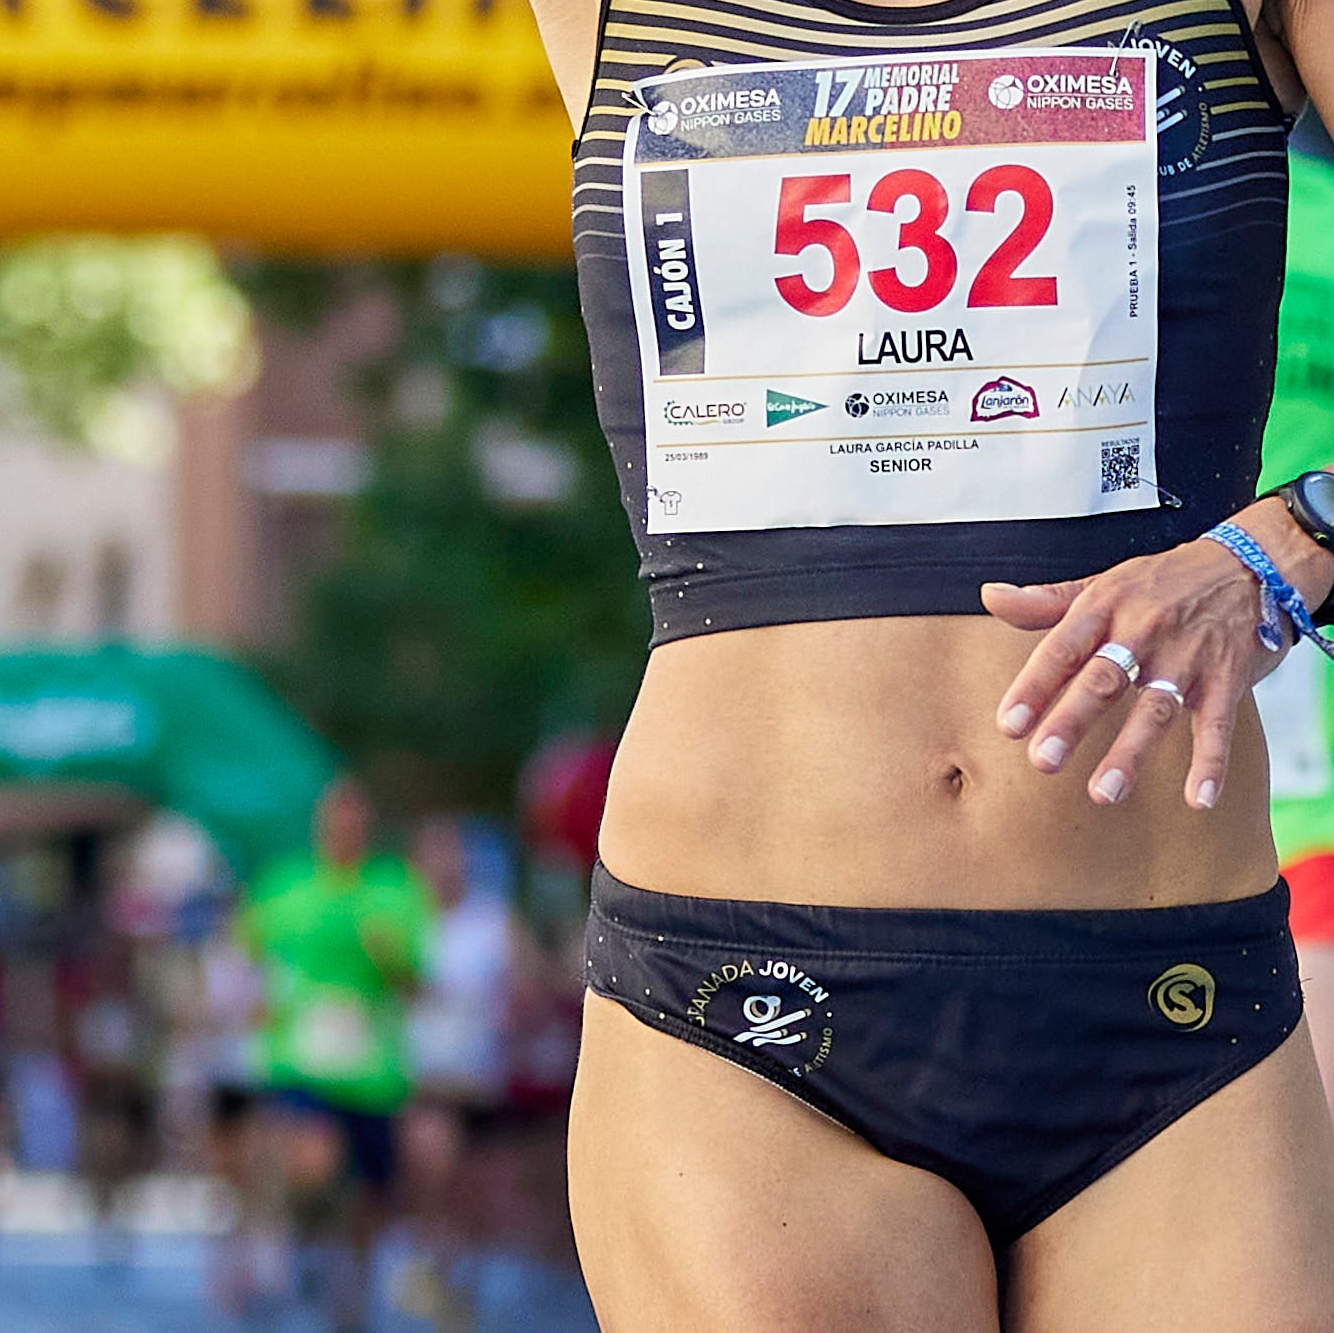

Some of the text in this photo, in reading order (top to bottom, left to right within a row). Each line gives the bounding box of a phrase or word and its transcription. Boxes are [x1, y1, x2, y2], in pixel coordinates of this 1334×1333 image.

[813, 63, 960, 117] 17 MEMORIAL
[1026, 74, 1134, 95] OXIMESA
[680, 88, 781, 115] OXIMESA
[864, 84, 954, 116] PADRE
[1027, 95, 1134, 111] NIPPON GASES
[680, 109, 781, 132] NIPPON GASES
[804, 110, 962, 146] MARCELINO
[1177, 157, 1193, 172] DE
[1126, 184, 1137, 215] 09:45
[773, 163, 1059, 317] 532
[1127, 218, 1137, 250] Salida
[653, 212, 696, 331] CAJÓN 1
[1128, 269, 1139, 318] PRUEBA
[857, 328, 973, 365] LAURA
[872, 390, 949, 406] OXIMESA
[980, 393, 1030, 410] Lanjarón
[1058, 382, 1136, 409] ANAYA
[670, 403, 745, 419] CALERO
[873, 406, 950, 418] NIPPON GASES
[829, 439, 980, 455] LAURA GARCÍA PADILLA
[869, 458, 932, 473] SENIOR
[758, 959, 830, 1004] JOVEN
